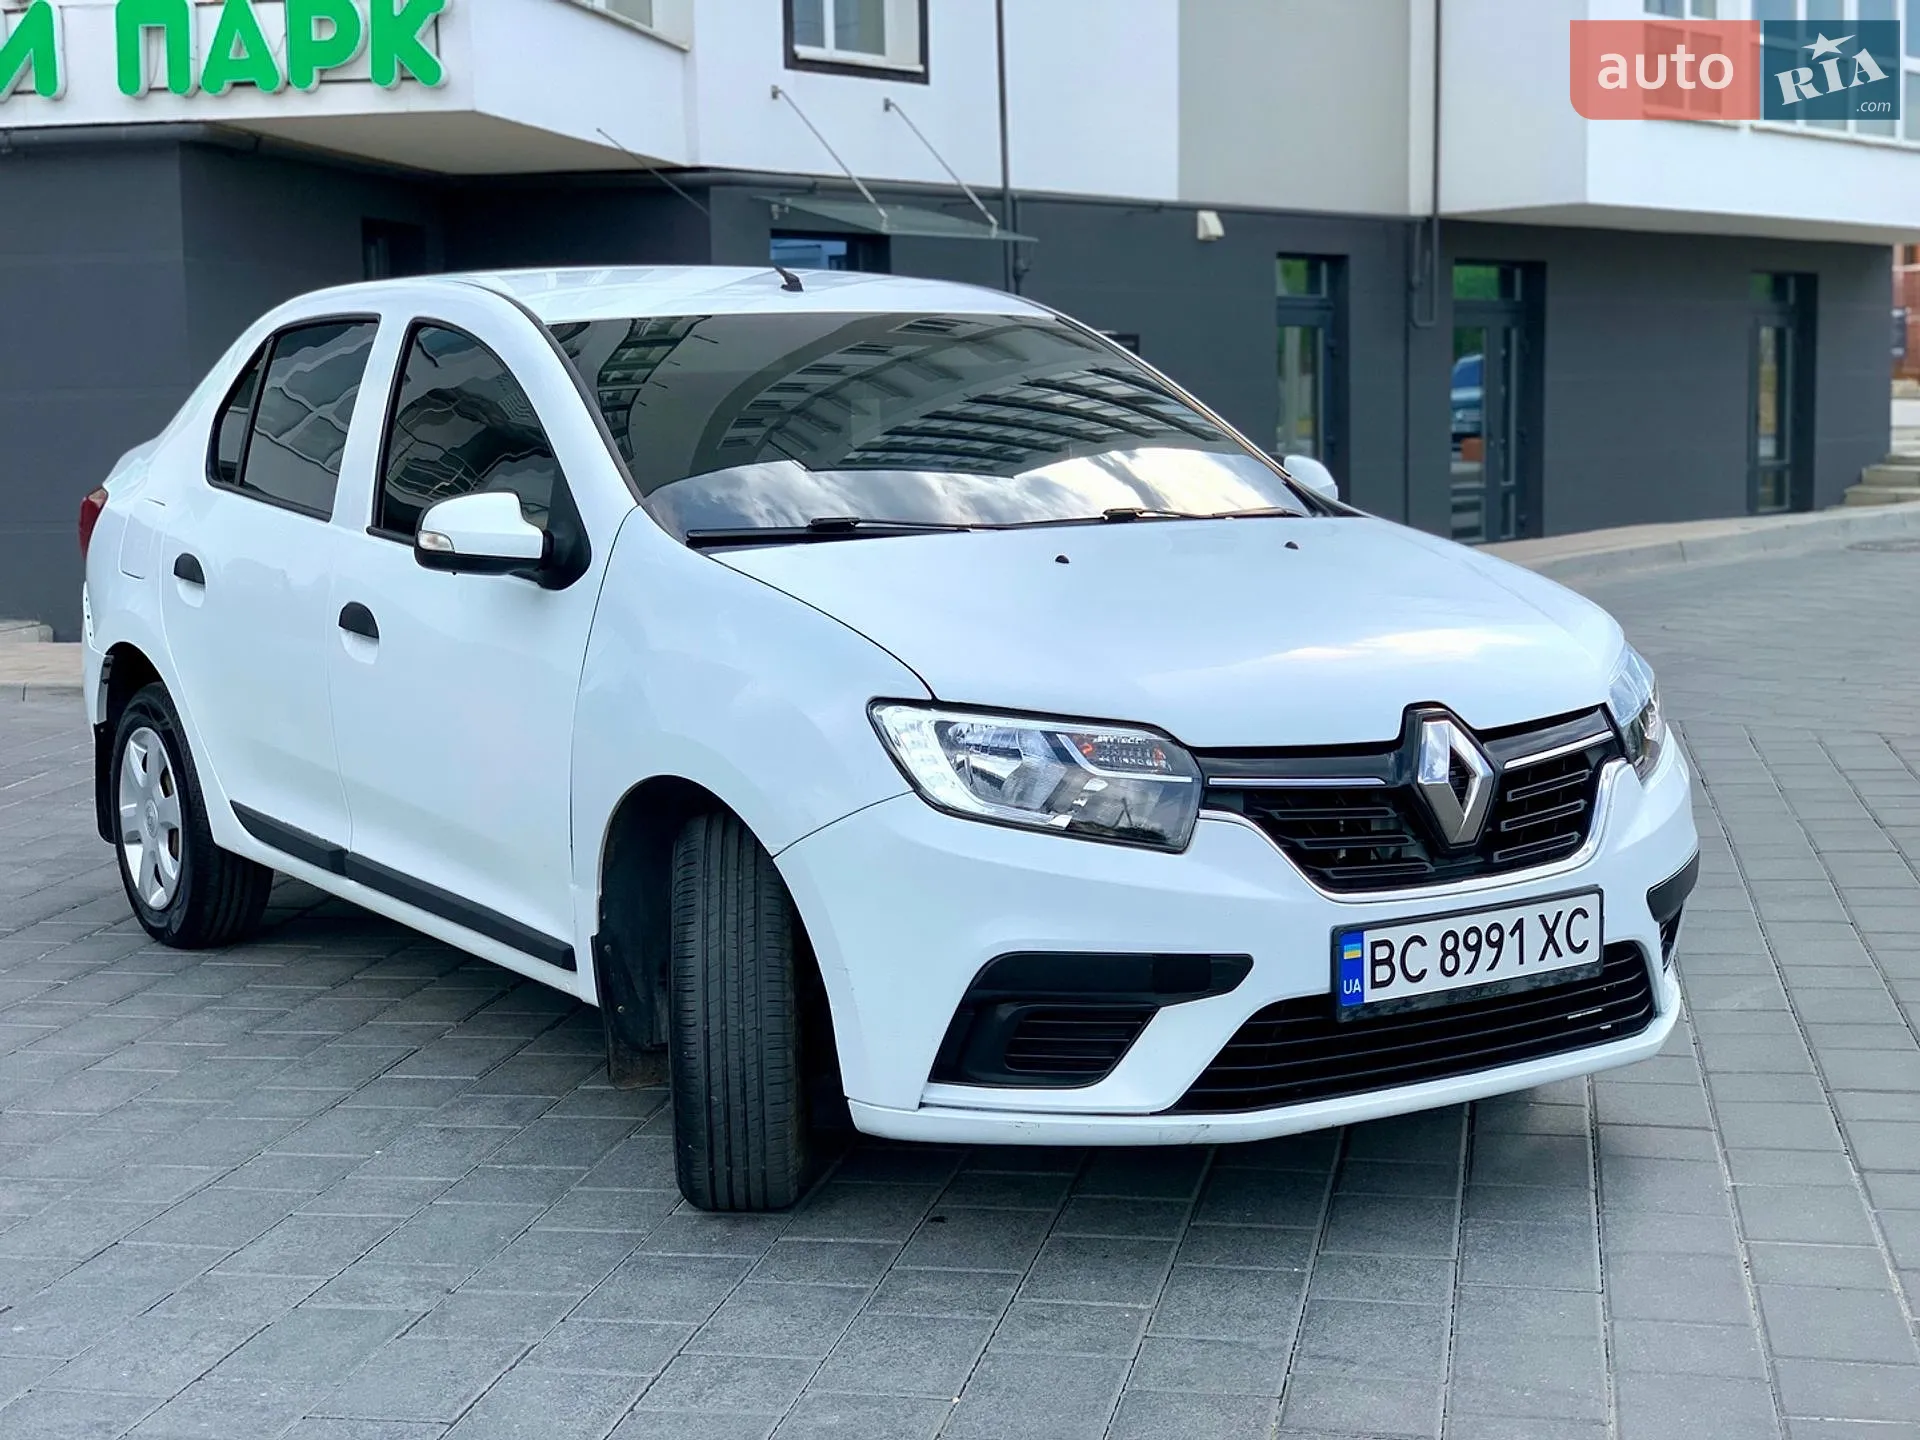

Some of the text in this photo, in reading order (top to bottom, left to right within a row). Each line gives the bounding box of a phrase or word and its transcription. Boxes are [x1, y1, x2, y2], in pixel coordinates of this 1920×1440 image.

[114, 0, 447, 97] ПАРК
[1343, 978, 1362, 995] UA
[1370, 907, 1590, 989] BC 8991 XC
